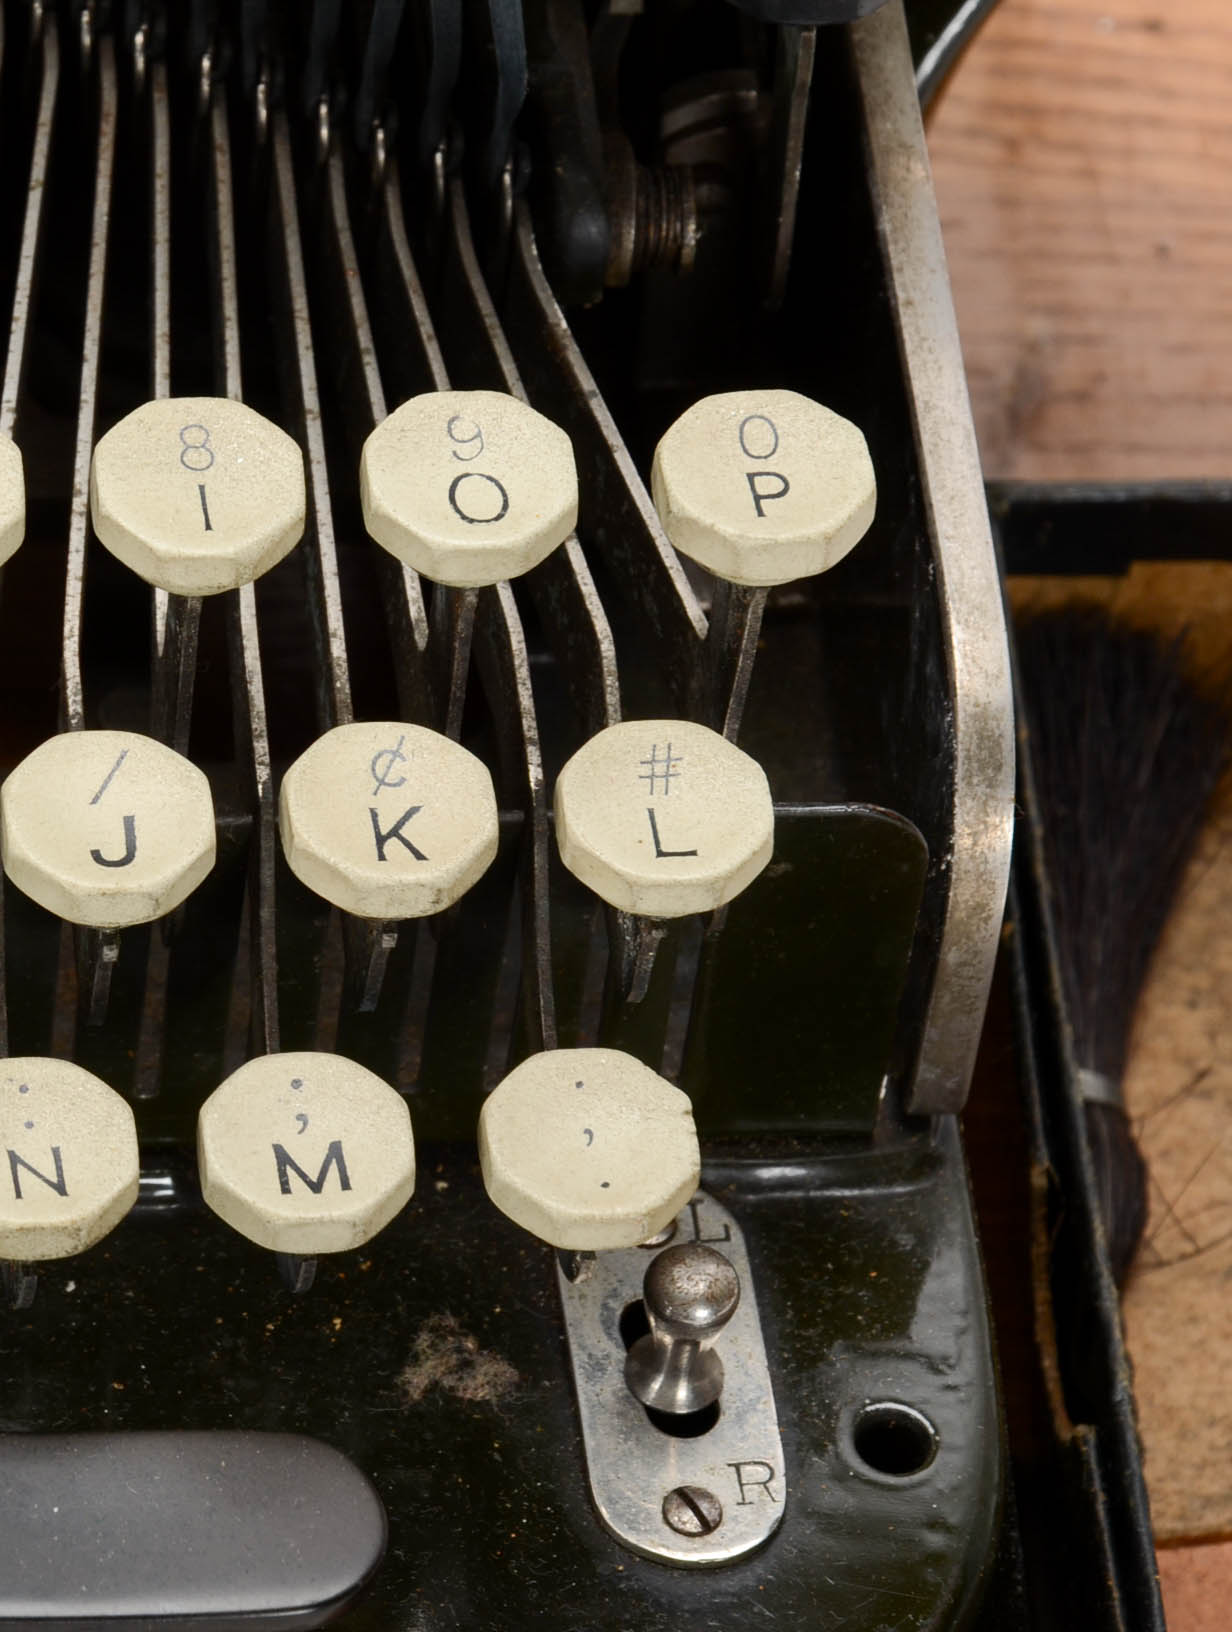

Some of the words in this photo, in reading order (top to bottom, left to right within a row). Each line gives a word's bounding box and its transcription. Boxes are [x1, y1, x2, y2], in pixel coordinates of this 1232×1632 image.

[179, 424, 214, 471] 8
[447, 415, 484, 462] 9
[199, 485, 212, 531] I
[449, 473, 509, 524] O
[746, 472, 790, 517] P
[89, 750, 129, 805] /
[371, 736, 406, 796] ¢
[638, 743, 683, 794] #
[90, 816, 136, 868] J
[370, 806, 428, 861] K
[648, 809, 698, 858] L
[291, 1079, 308, 1134] ;
[7, 1147, 69, 1199] N
[272, 1141, 352, 1194] M
[686, 1198, 731, 1244] L
[727, 1460, 778, 1505] R
